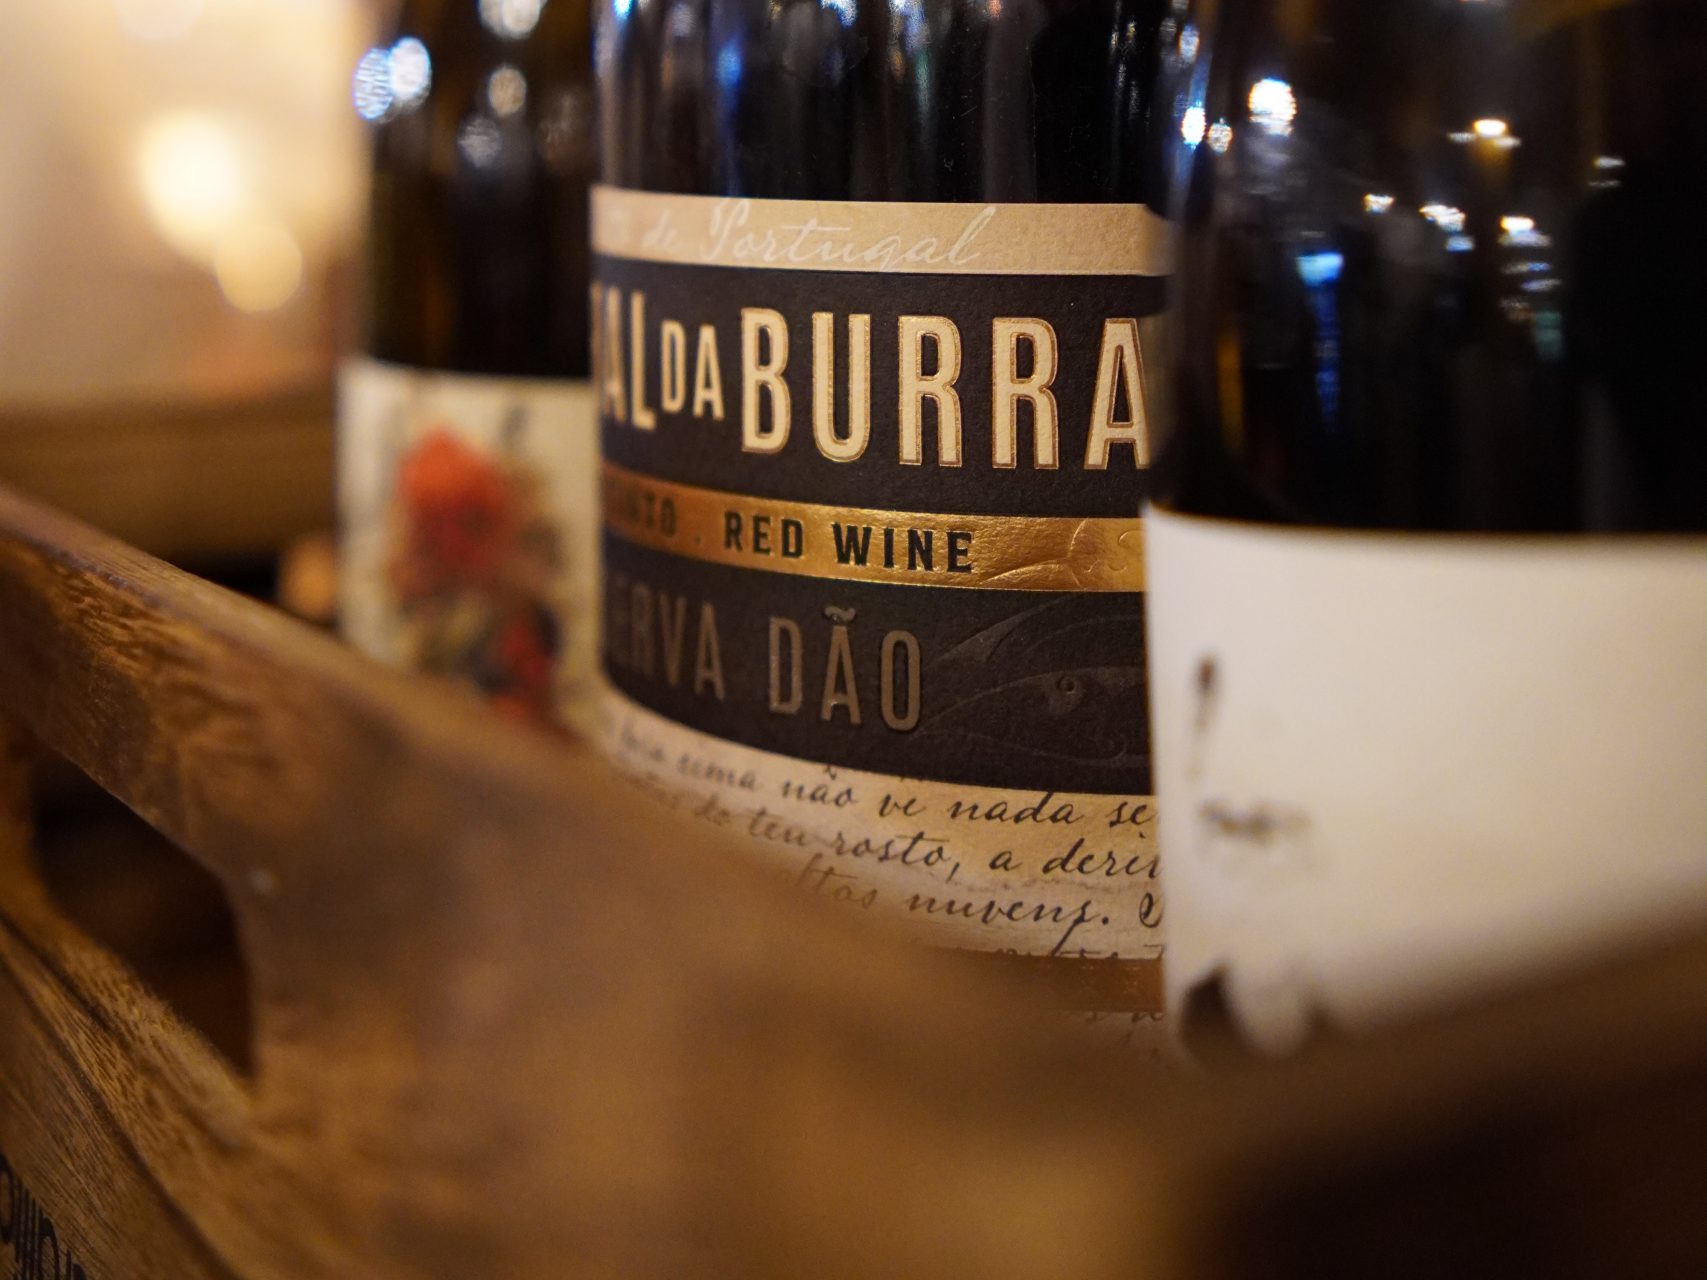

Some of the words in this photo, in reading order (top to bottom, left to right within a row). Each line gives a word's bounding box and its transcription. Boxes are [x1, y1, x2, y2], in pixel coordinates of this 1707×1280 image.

[699, 198, 995, 273] Portugal
[660, 320, 725, 421] DA
[741, 306, 1151, 471] BURRA
[724, 508, 806, 559] RED
[831, 522, 975, 573] WINE
[768, 605, 922, 732] DÃO
[946, 793, 1084, 826] nada
[833, 831, 962, 883] rosto,
[989, 850, 1023, 872] a
